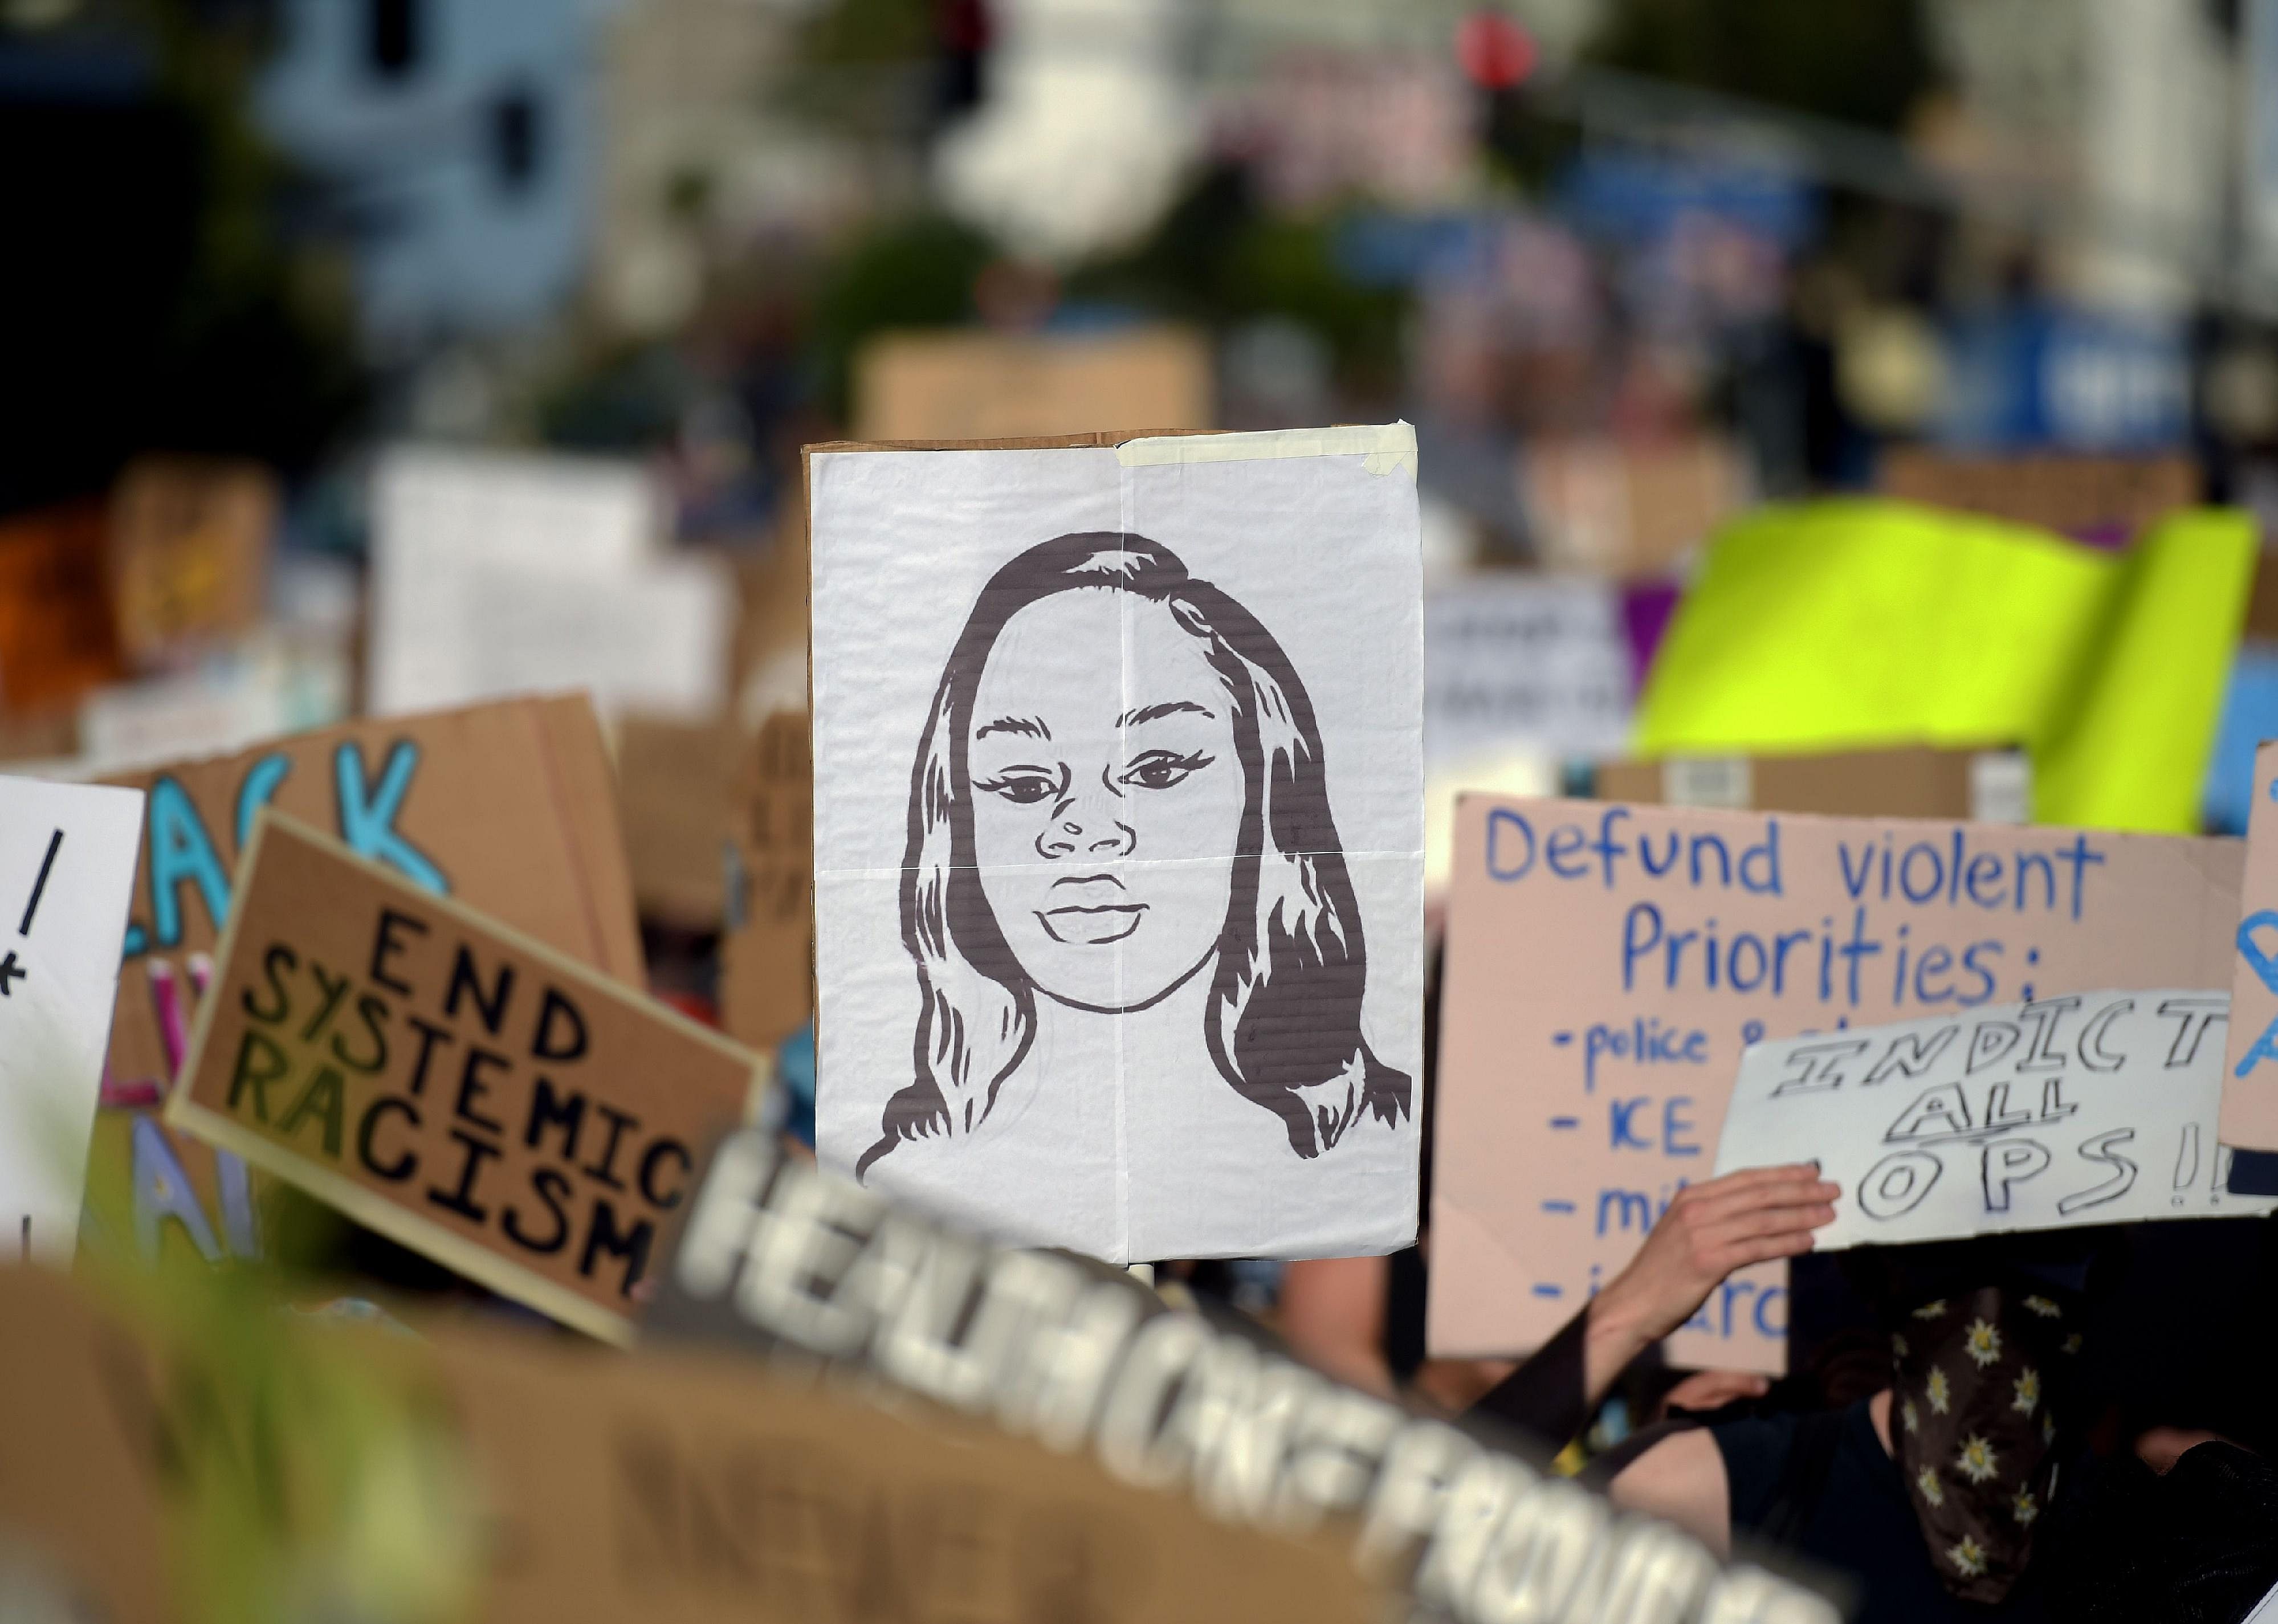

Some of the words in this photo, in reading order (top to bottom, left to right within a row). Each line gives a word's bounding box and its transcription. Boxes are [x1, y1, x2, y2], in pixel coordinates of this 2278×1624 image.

[1484, 807, 1784, 896] Defund
[1838, 829, 2106, 921] violent
[369, 906, 589, 1064] END
[1621, 901, 2039, 1009] Priorities:
[242, 945, 692, 1209] SYSTEMIC
[1767, 996, 2231, 1100] INDICT
[226, 1031, 657, 1297] RACISM
[1608, 1096, 1702, 1158] ICE
[1884, 1077, 2079, 1143] ALL
